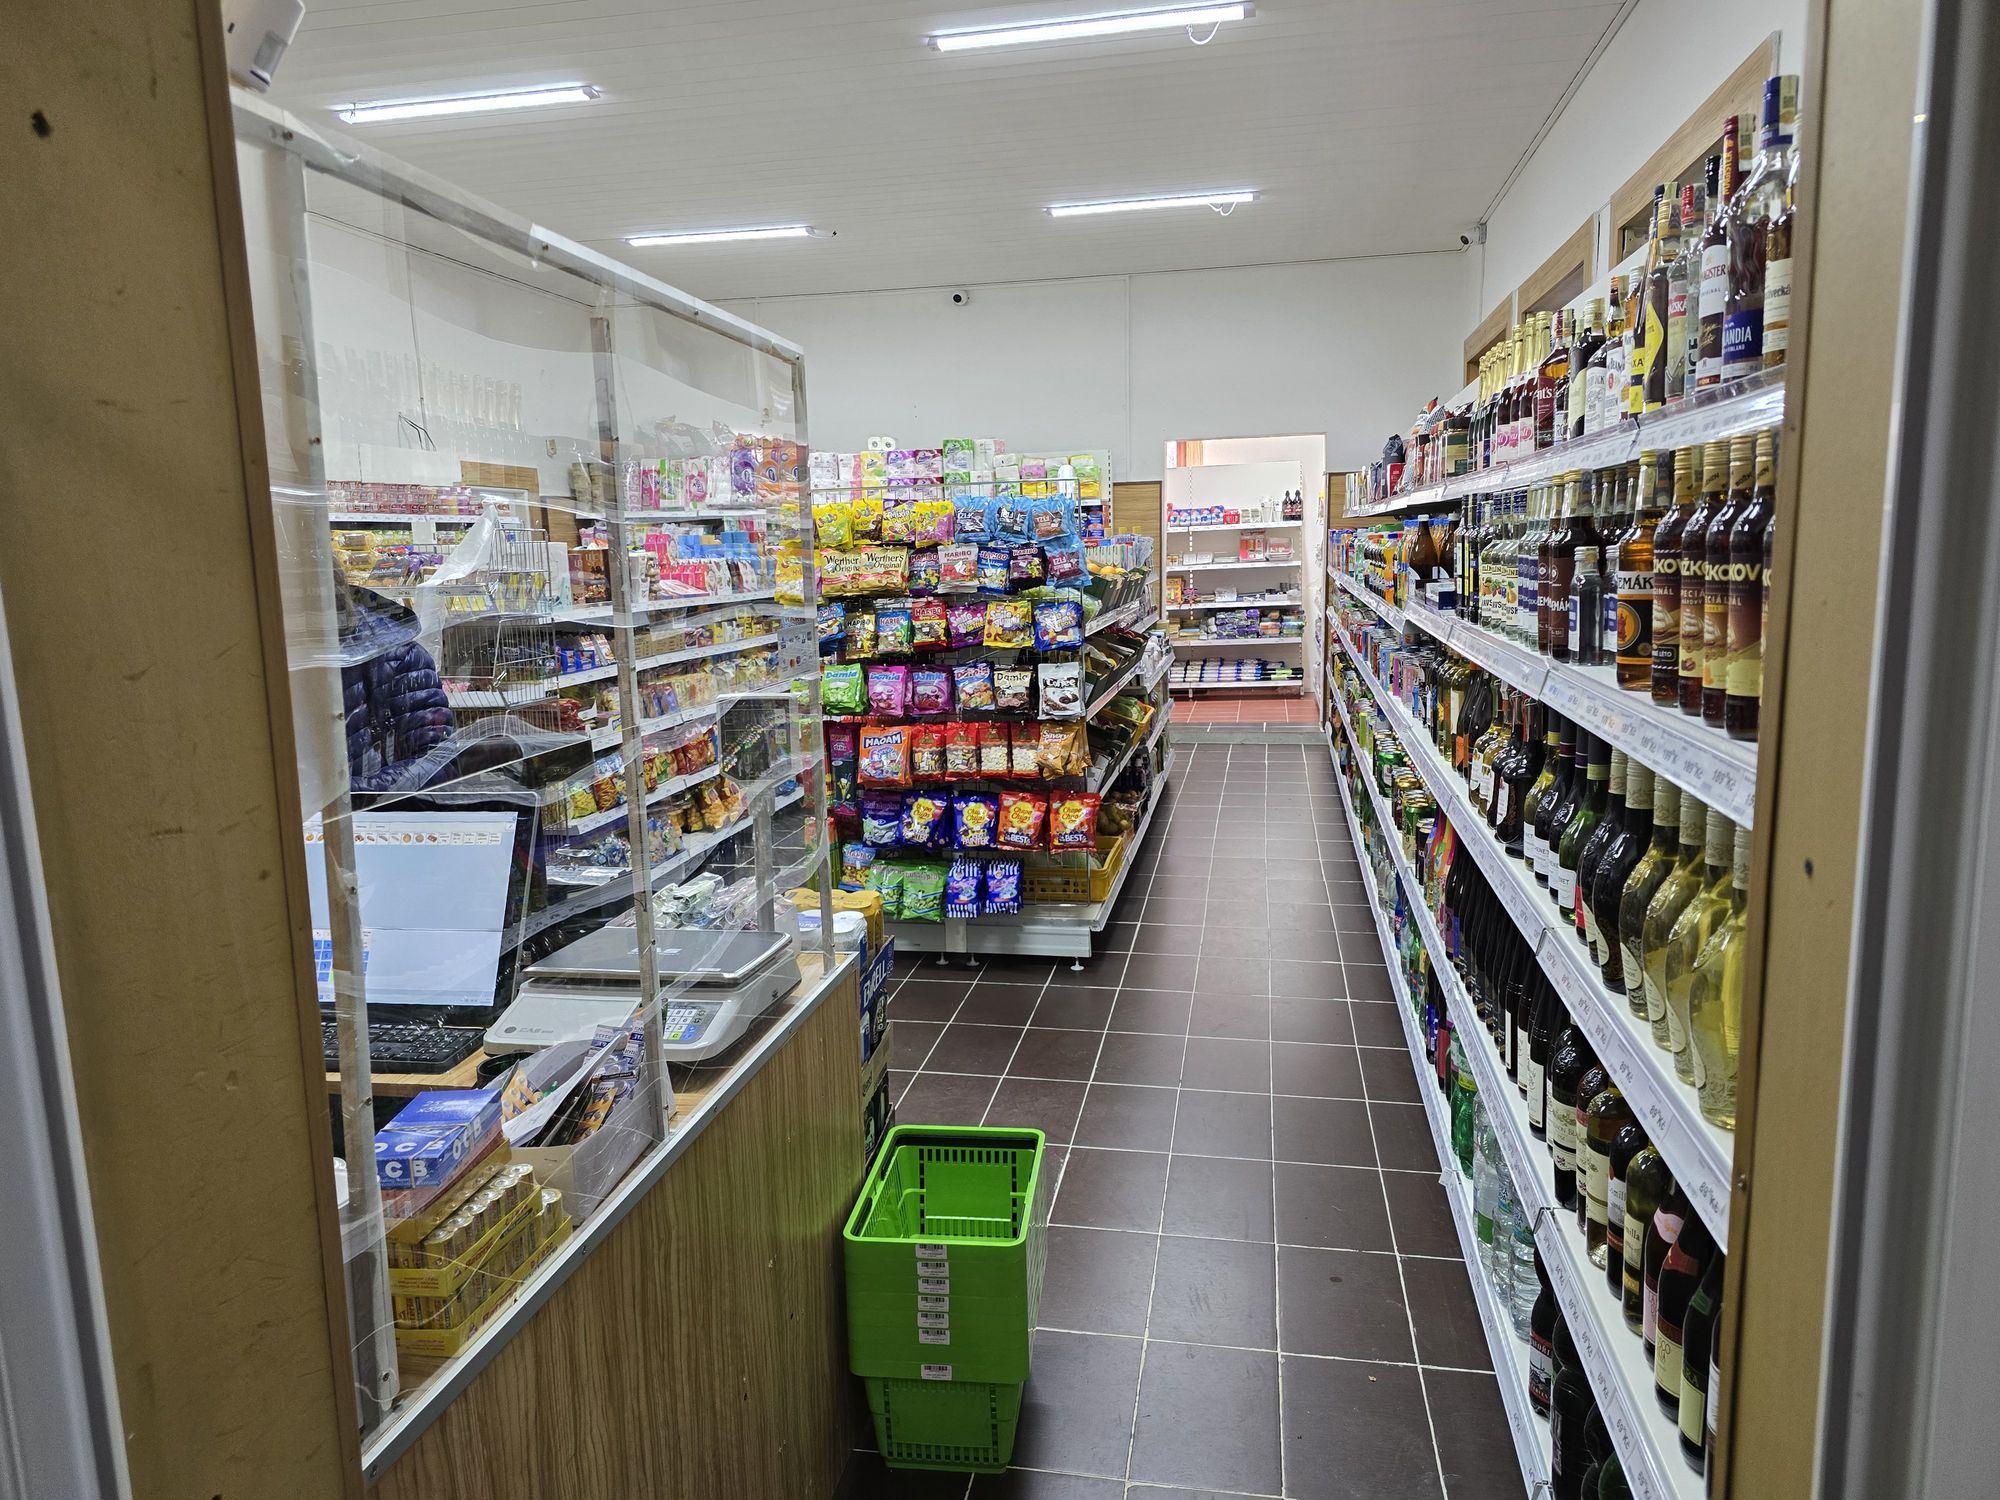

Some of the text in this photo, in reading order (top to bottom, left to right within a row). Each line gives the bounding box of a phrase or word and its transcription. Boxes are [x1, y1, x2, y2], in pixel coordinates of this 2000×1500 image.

[944, 550, 972, 558] HARIBO
[1012, 548, 1039, 556] HARIBO
[865, 552, 904, 563] Werther's
[873, 559, 902, 570] Original
[913, 607, 943, 617] HARIBO
[847, 618, 871, 627] HARIBO
[879, 617, 905, 625] HARIBO
[1046, 678, 1077, 688] Coffee
[865, 733, 901, 748] MAOAM
[1010, 834, 1028, 843] BEST
[1065, 834, 1083, 843] BEST
